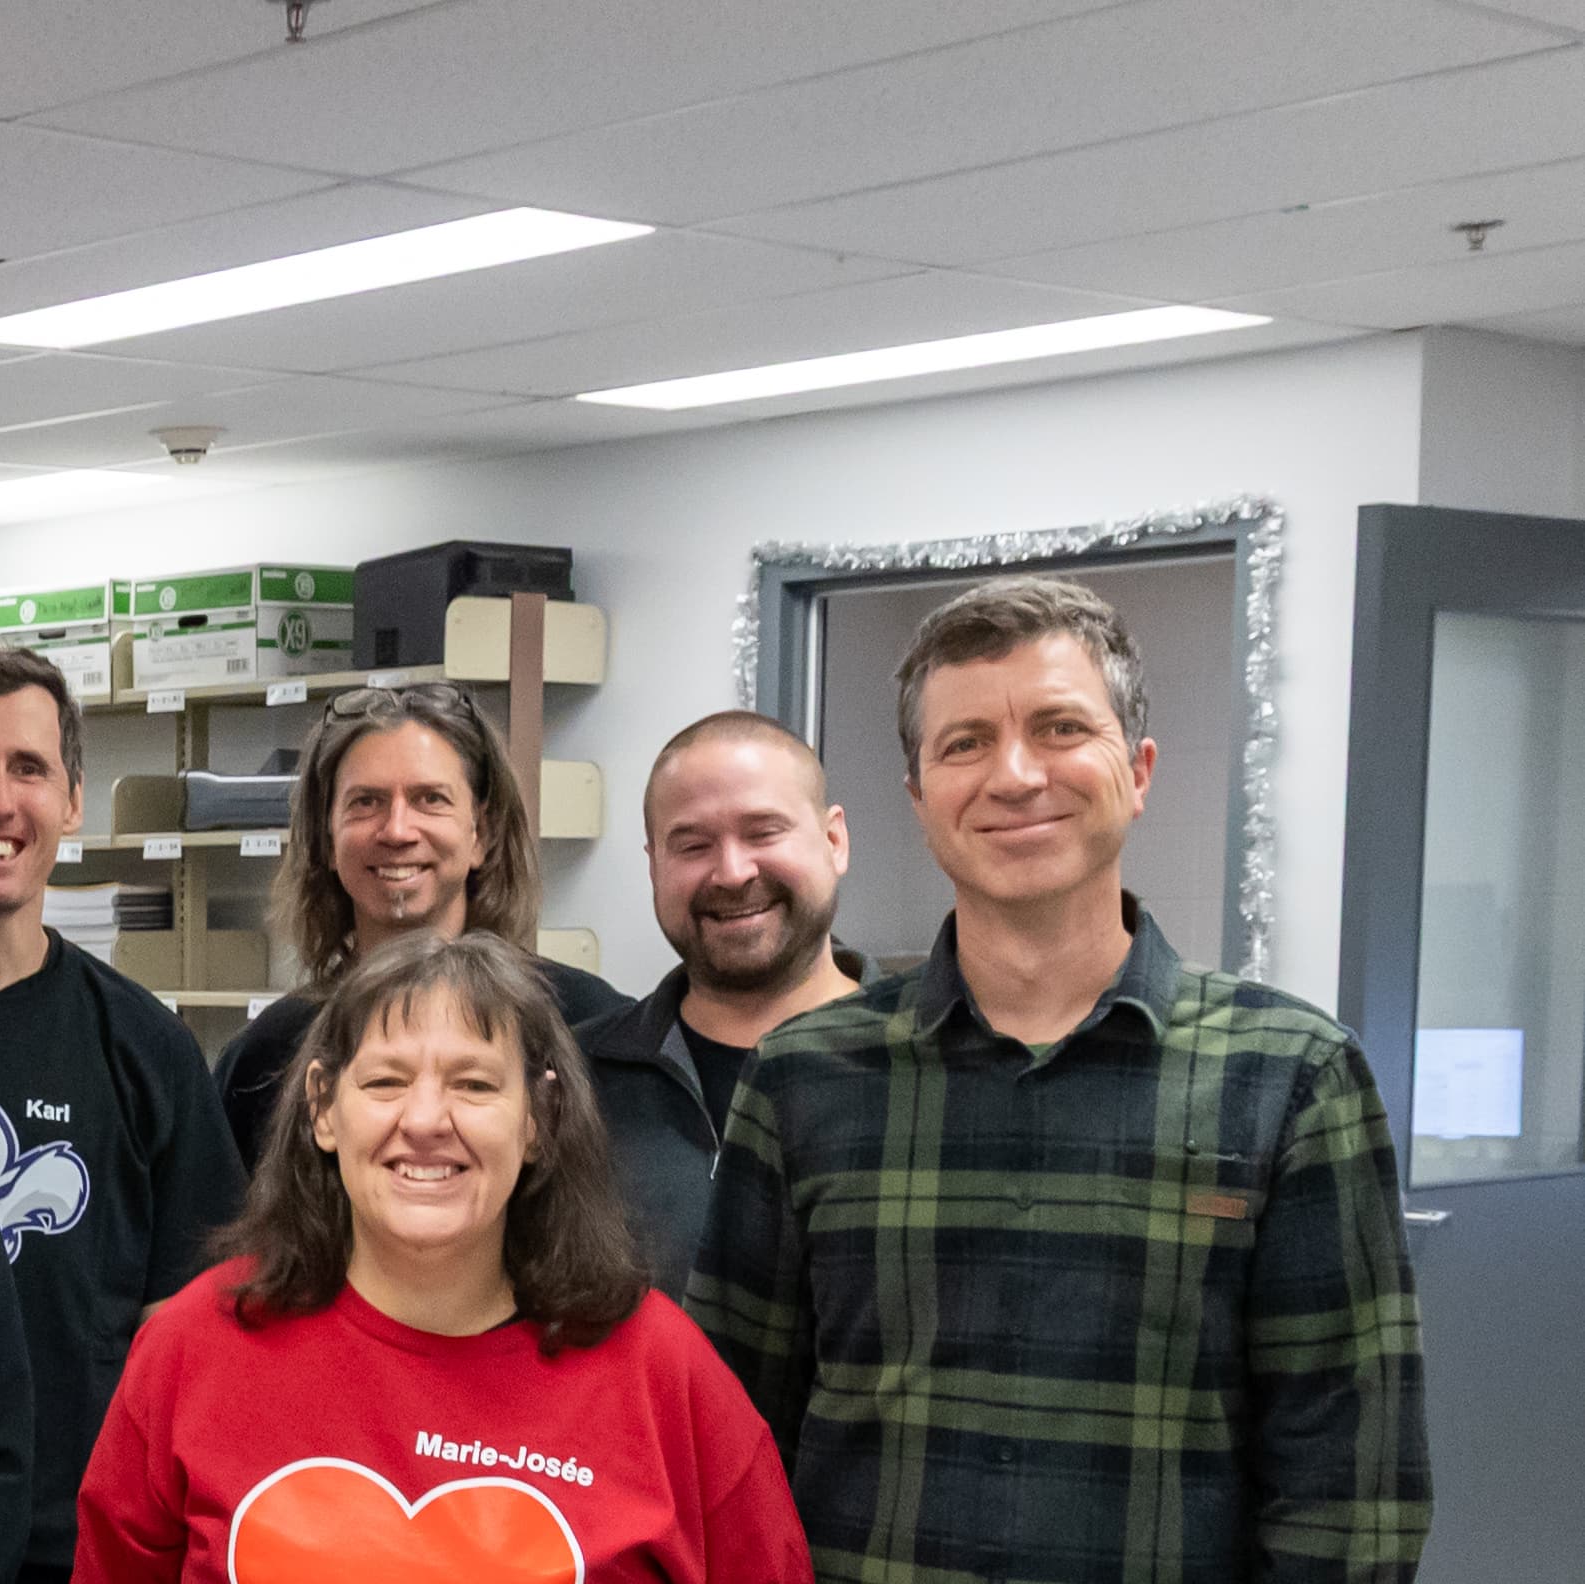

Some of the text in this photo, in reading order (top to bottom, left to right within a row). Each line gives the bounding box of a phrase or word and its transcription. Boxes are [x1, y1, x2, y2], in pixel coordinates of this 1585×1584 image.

[284, 616, 306, 652] X9
[26, 1099, 71, 1123] Karl
[415, 1430, 595, 1487] Marie-Josée
